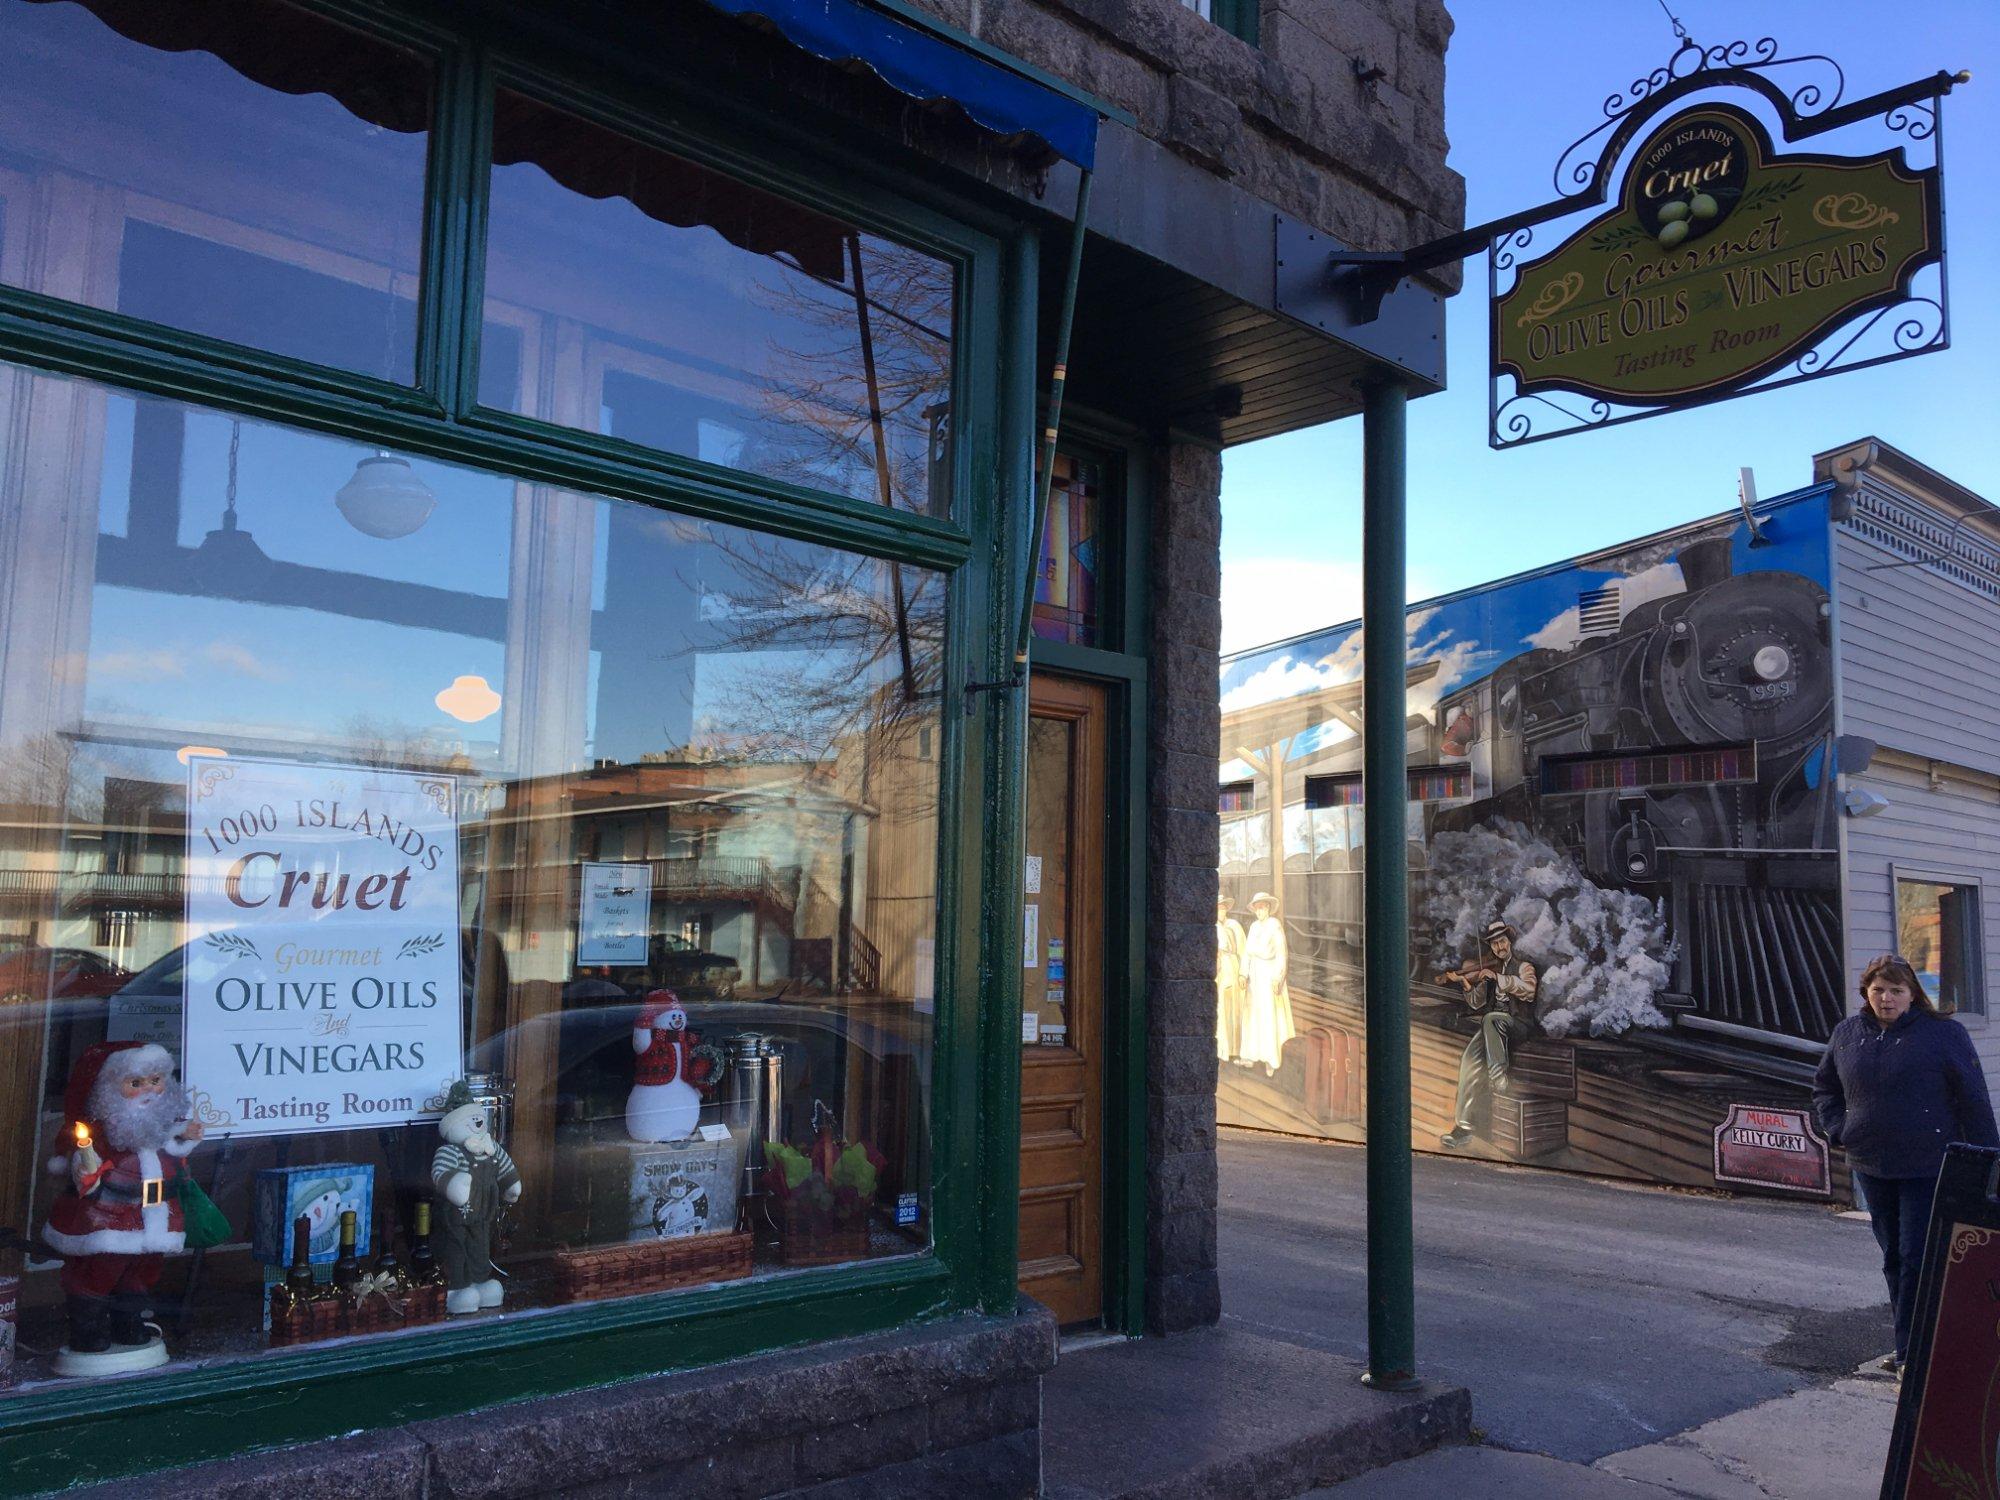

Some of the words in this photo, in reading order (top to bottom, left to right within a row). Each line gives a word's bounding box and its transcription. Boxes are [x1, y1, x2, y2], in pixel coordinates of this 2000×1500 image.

[1646, 142, 1672, 168] 1000
[1676, 128, 1734, 148] ISLANDS
[1645, 151, 1733, 198] Cruet
[1604, 211, 1787, 300] Gourmet
[1528, 311, 1611, 362] OLIVE
[1619, 289, 1689, 338] OILS
[1723, 235, 1888, 310] VINEGARS
[1613, 343, 1697, 377] Tasting
[1710, 322, 1780, 353] Room
[1755, 681, 1789, 699] 999
[202, 804, 277, 855] 1000
[297, 799, 444, 871] ISLANDS
[225, 852, 411, 911] Cruet
[603, 905, 629, 916] Baskets
[274, 942, 382, 974] Gourmet
[215, 977, 337, 1011] OLIVE
[352, 977, 437, 1010] OILS
[308, 1013, 352, 1039] And
[1042, 1034, 1050, 1042] 24
[231, 1042, 424, 1077] VINEGARS
[237, 1096, 330, 1123] Tasting
[342, 1092, 413, 1115] Room
[1746, 1111, 1788, 1128] MURAL
[1733, 1129, 1764, 1146] KELLY
[1767, 1132, 1802, 1150] CURRY
[644, 1160, 682, 1177] SNOW
[686, 1158, 717, 1173] DAYS
[900, 1207, 915, 1216] 2012
